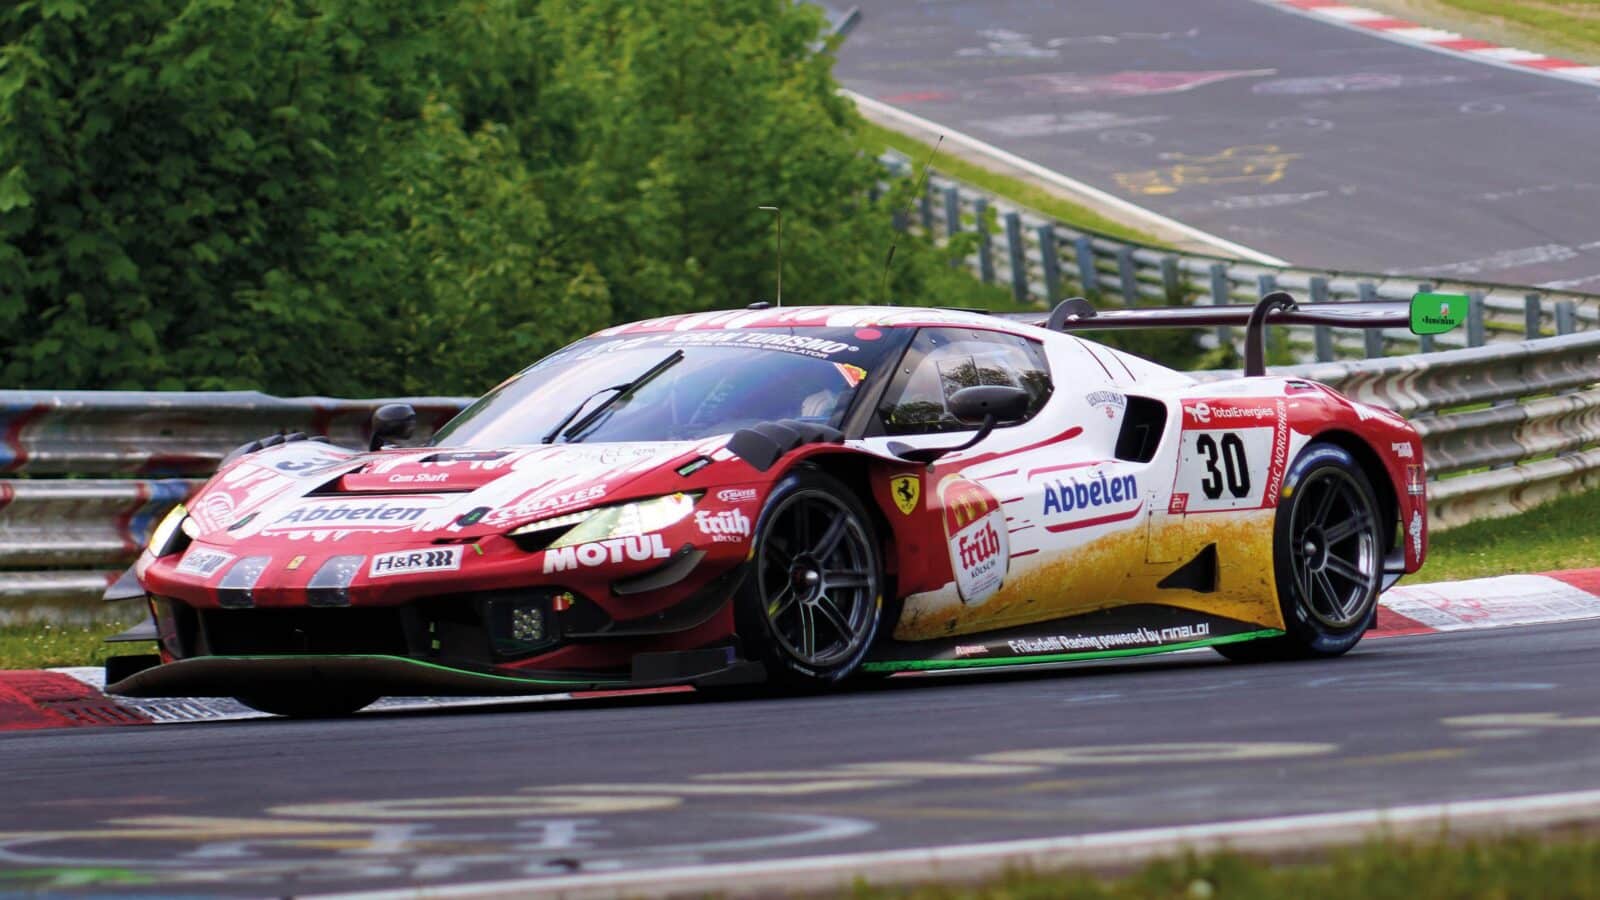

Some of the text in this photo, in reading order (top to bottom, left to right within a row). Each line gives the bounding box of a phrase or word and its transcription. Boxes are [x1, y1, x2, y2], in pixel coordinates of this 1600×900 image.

[1210, 404, 1275, 420] TotalEnergies
[415, 472, 449, 483] Shaft
[1196, 432, 1251, 500] 30
[1043, 473, 1138, 515] Abbelen
[1268, 467, 1283, 505] ADAC
[282, 505, 427, 523] Abbelen
[693, 508, 751, 538] früh
[542, 533, 671, 575] MOTUL
[958, 520, 1001, 571] früh
[375, 554, 422, 571] H&R
[1007, 634, 1064, 655] Frikadelli
[1062, 632, 1100, 652] Racing
[1098, 628, 1146, 650] powered
[1143, 627, 1161, 645] by
